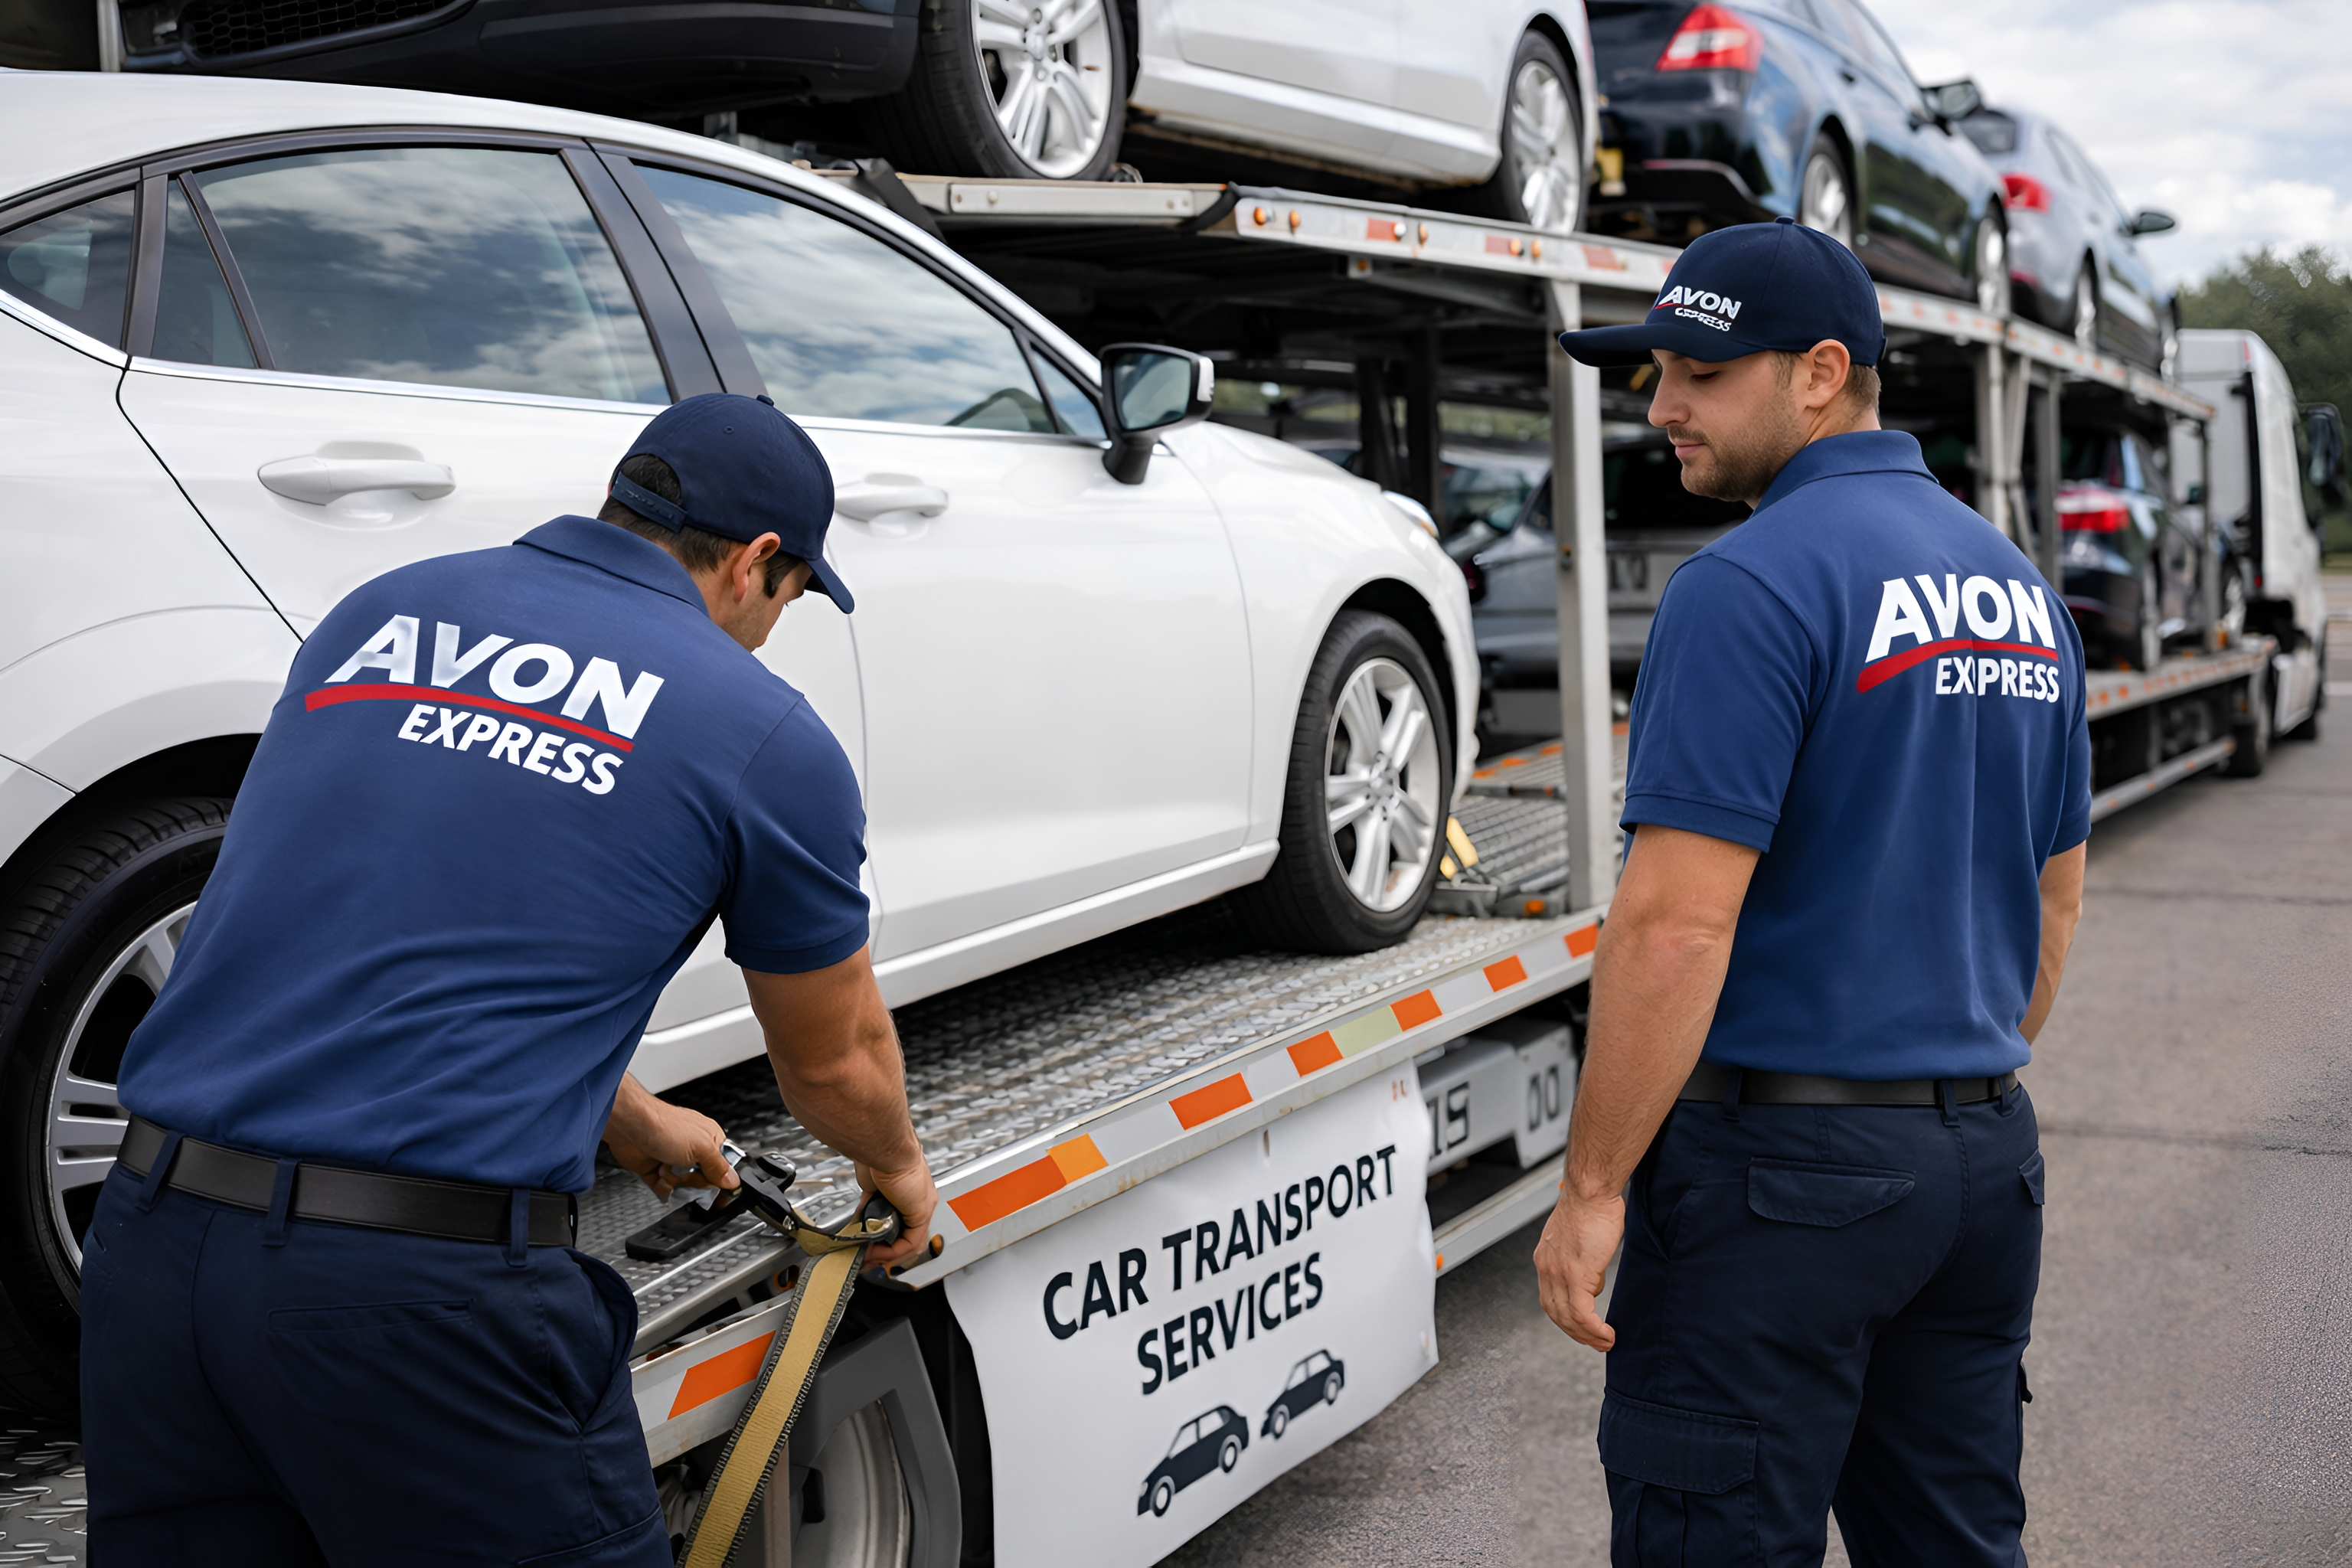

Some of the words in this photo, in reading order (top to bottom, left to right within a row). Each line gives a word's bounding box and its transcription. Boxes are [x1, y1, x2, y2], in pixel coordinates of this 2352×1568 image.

[1658, 285, 1742, 319] AVON
[1865, 573, 2056, 663] AVON
[325, 614, 665, 740] AVON
[1935, 655, 2060, 703] EXPRESS
[397, 704, 624, 795] EXPRESS
[1042, 1247, 1149, 1340] CAR
[1161, 1145, 1396, 1292] TRANSPORT
[1137, 1252, 1324, 1396] SERVICES
